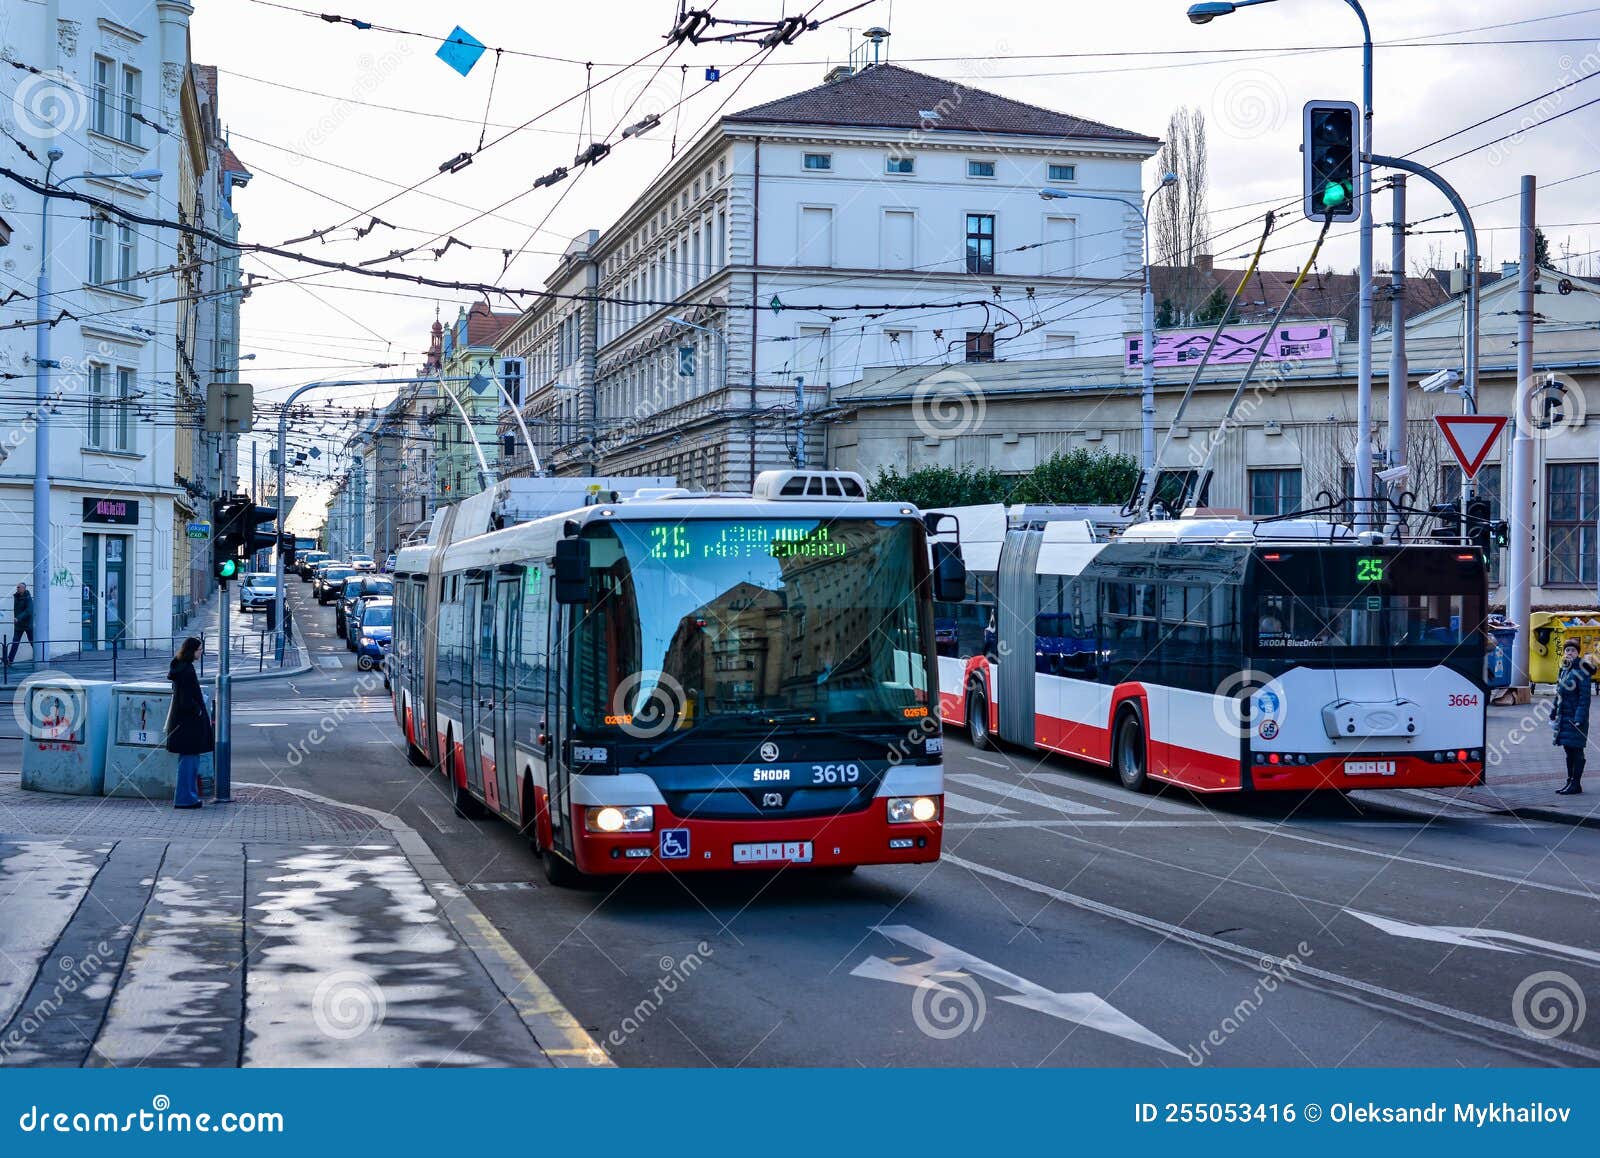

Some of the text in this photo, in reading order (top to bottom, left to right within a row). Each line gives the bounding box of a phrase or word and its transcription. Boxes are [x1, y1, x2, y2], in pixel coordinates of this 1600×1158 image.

[1357, 559, 1383, 581] 25
[1448, 694, 1478, 707] 3664
[138, 732, 147, 742] 13
[753, 767, 791, 781] ŠKODA
[811, 763, 860, 784] 3619
